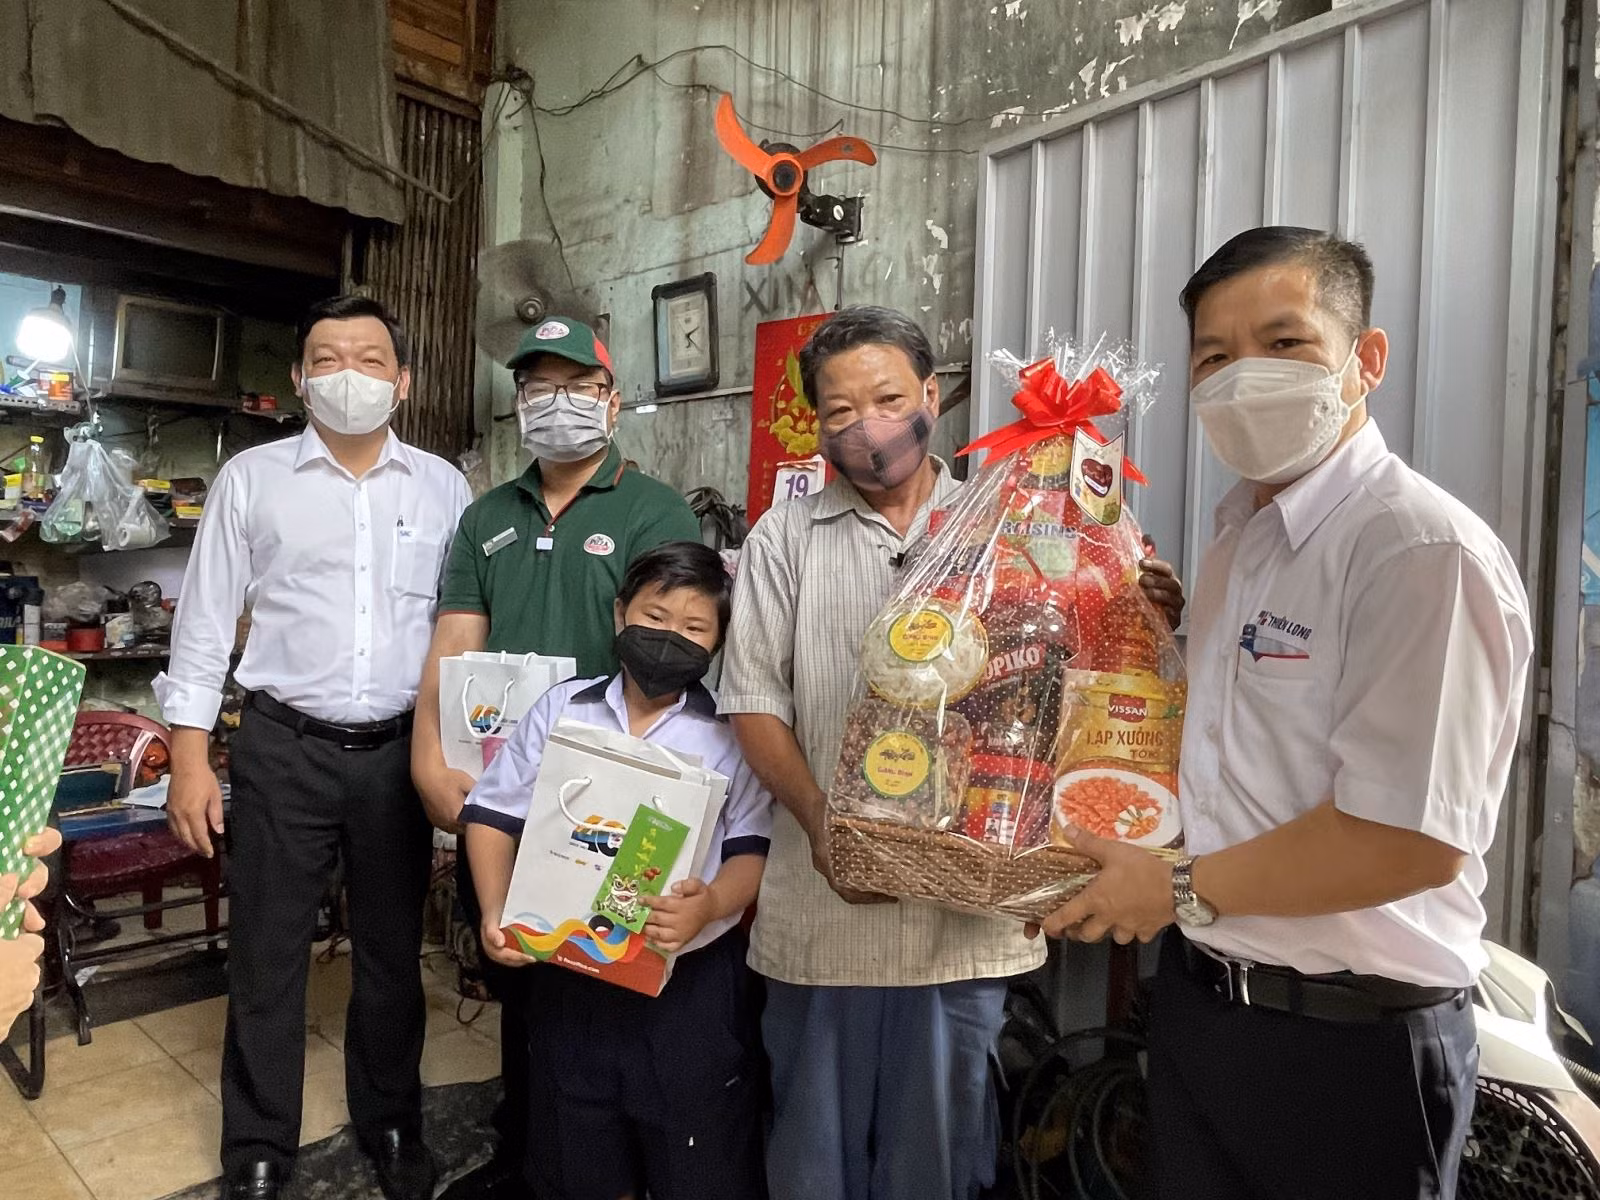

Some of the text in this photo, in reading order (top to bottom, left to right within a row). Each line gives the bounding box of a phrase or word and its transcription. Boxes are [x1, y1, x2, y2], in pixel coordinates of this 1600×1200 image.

[786, 474, 809, 501] 19
[1000, 521, 1077, 539] RAISINS
[1286, 622, 1312, 640] LONG
[983, 647, 1040, 680] OPIKO
[1107, 704, 1148, 716] VISSAN
